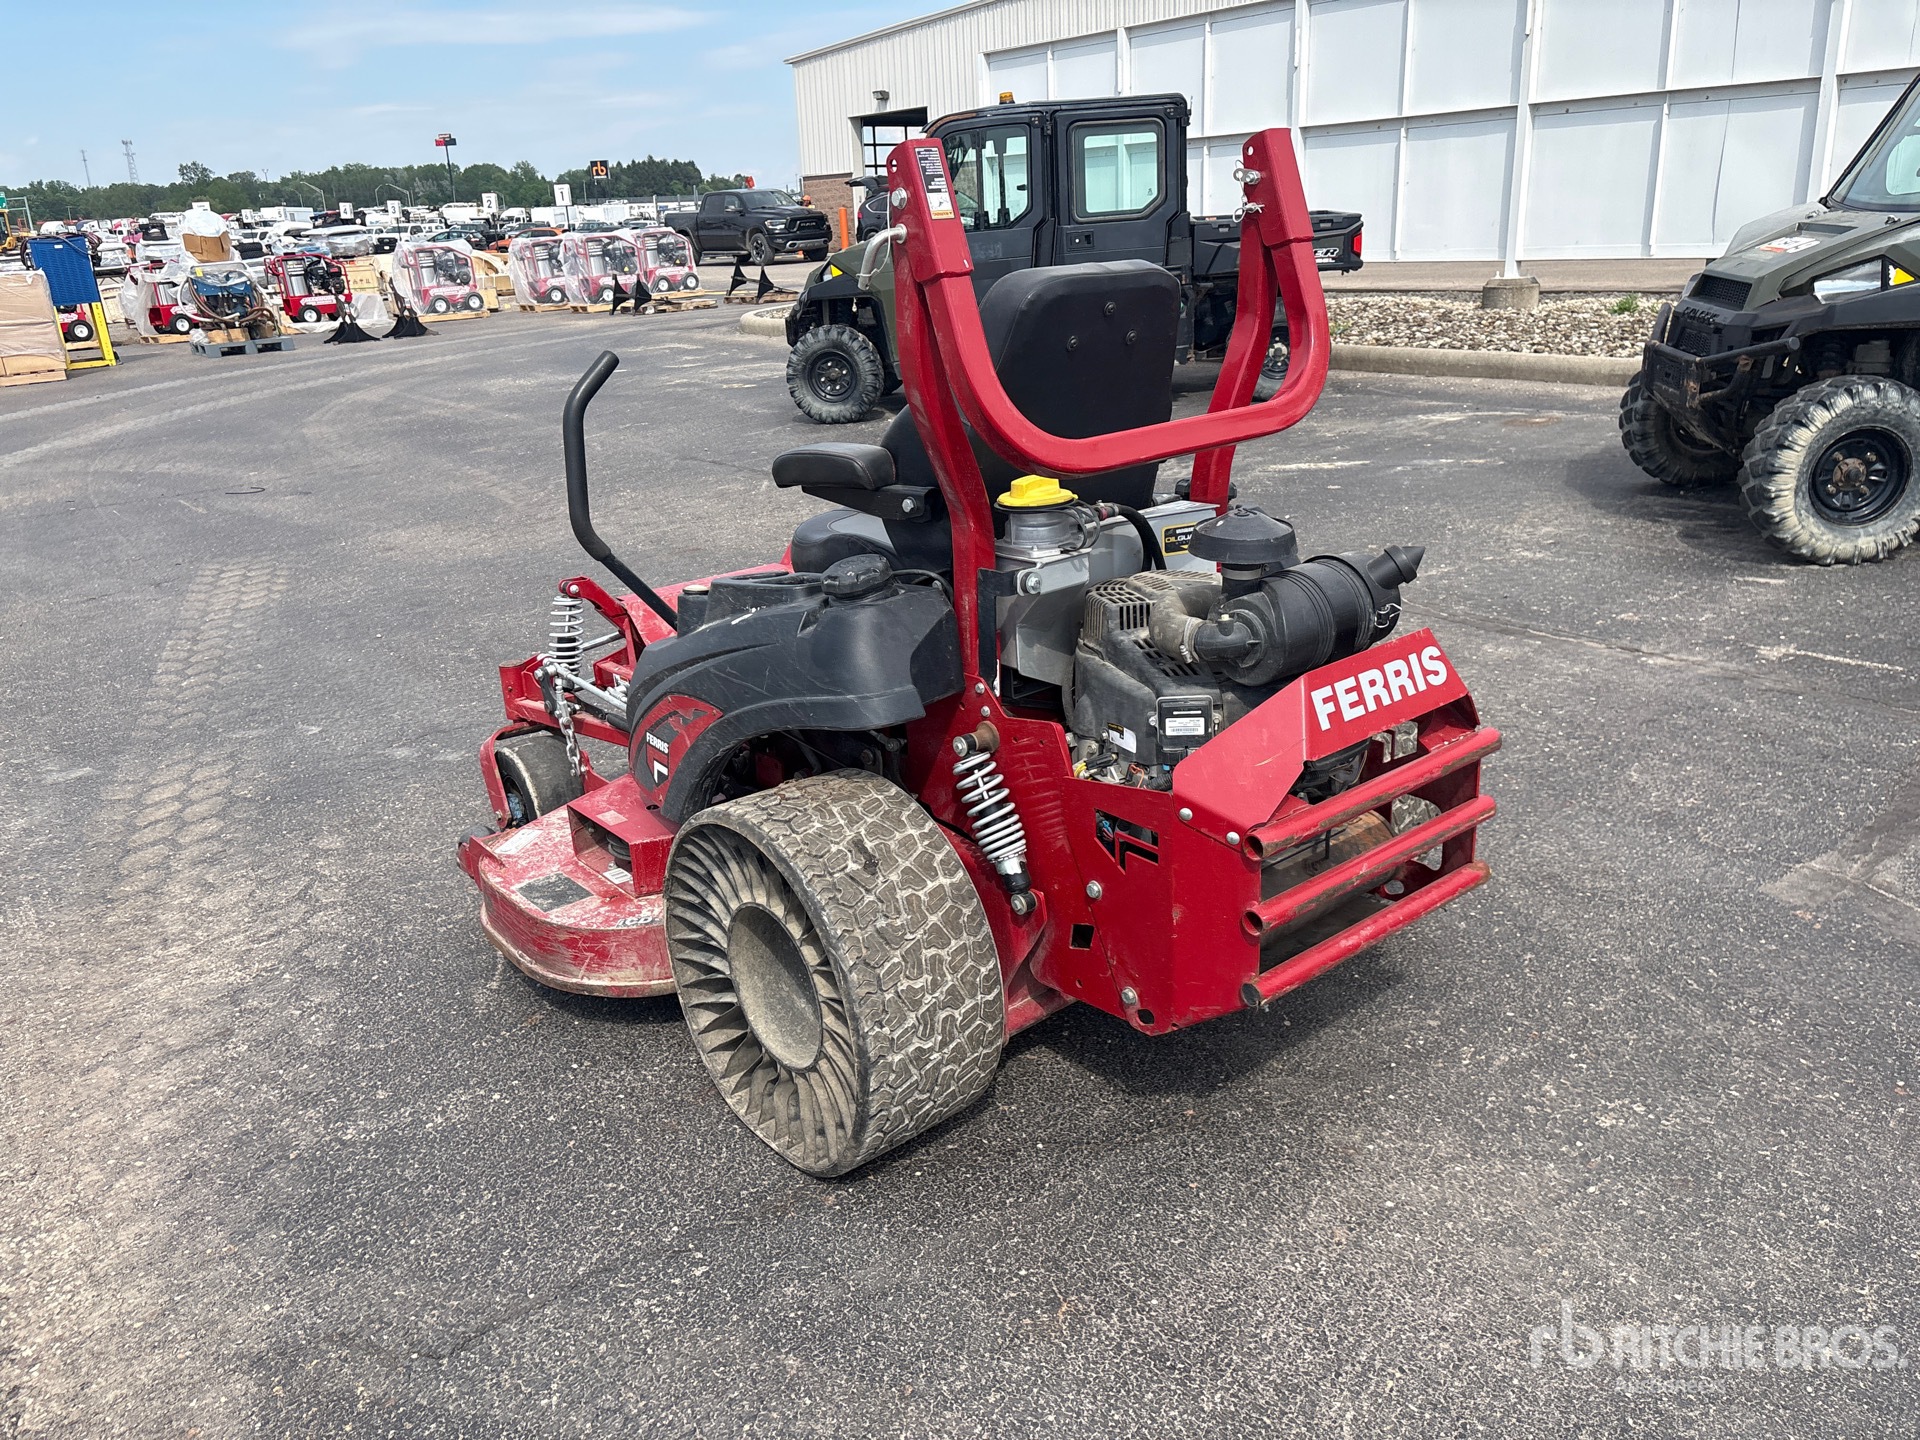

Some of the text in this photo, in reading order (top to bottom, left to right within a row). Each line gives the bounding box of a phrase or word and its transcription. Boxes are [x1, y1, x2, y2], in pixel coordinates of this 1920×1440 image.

[592, 161, 607, 176] rb
[390, 205, 397, 214] 3
[486, 199, 493, 209] 2
[1310, 646, 1448, 732] FERRIS
[646, 731, 669, 754] FERRIS
